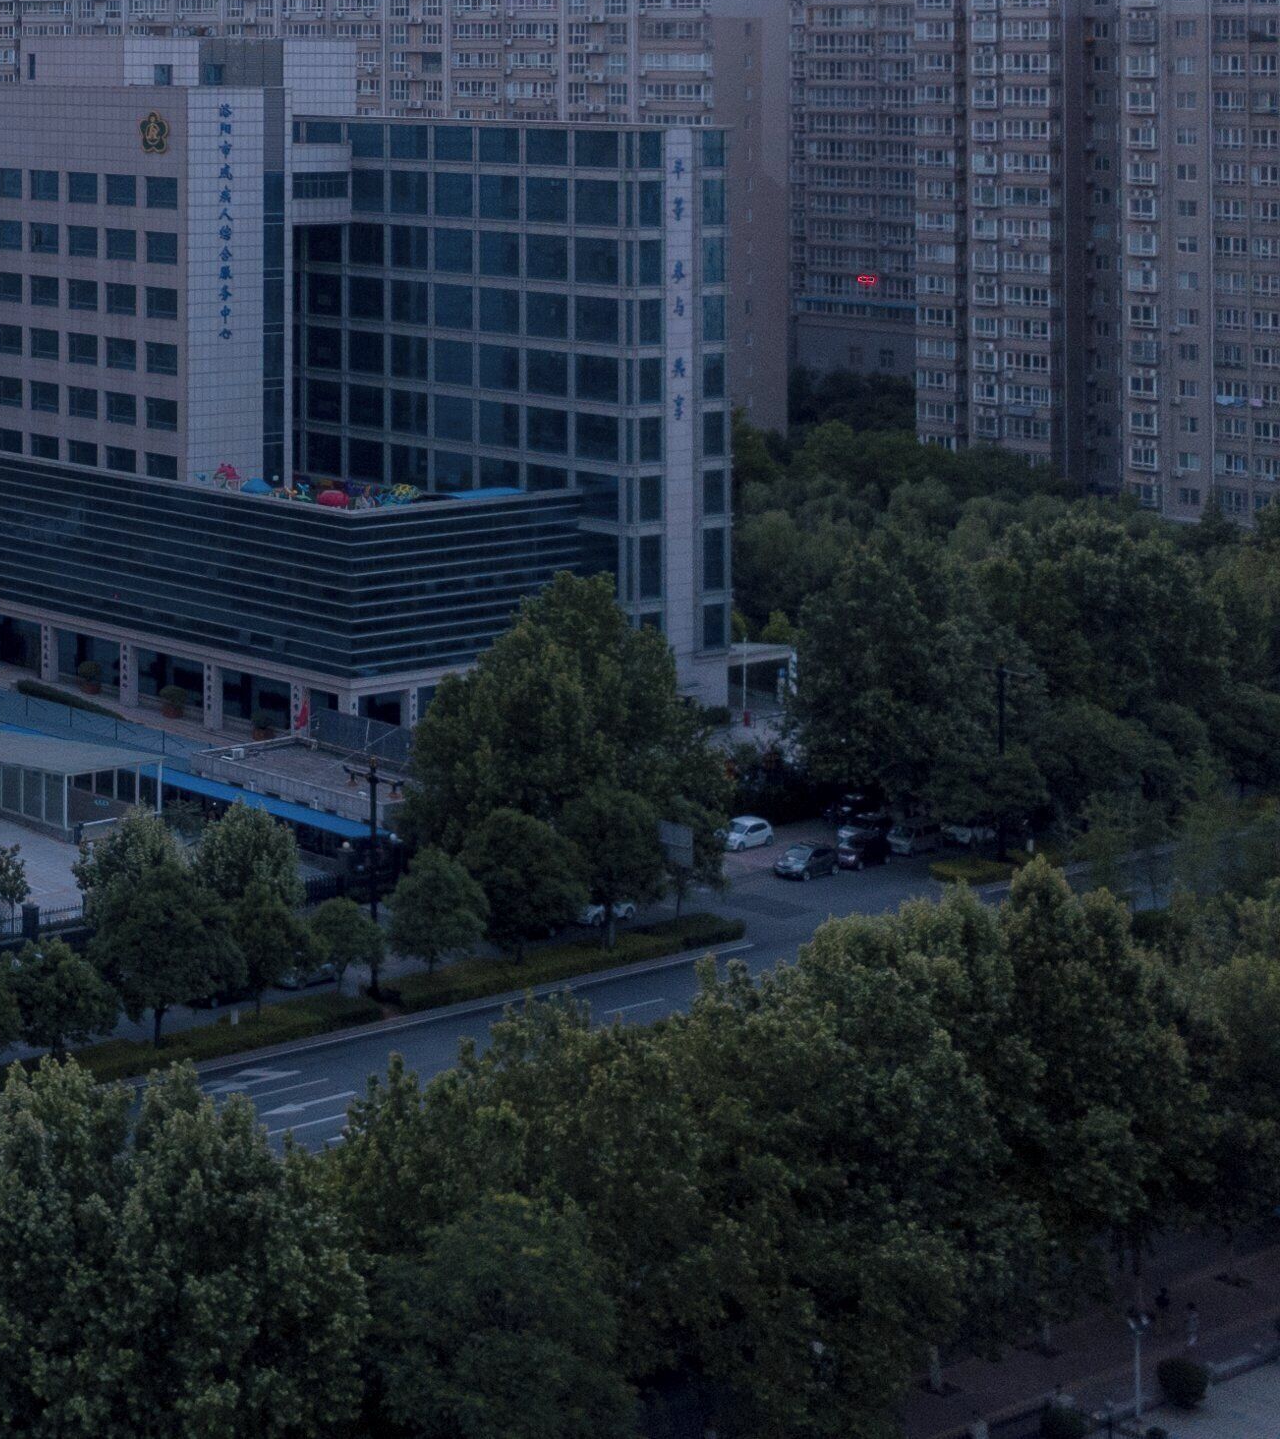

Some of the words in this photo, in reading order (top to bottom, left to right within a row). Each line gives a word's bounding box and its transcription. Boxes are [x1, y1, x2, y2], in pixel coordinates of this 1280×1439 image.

[218, 103, 234, 340] 洛阳市残疾人综合服务中心
